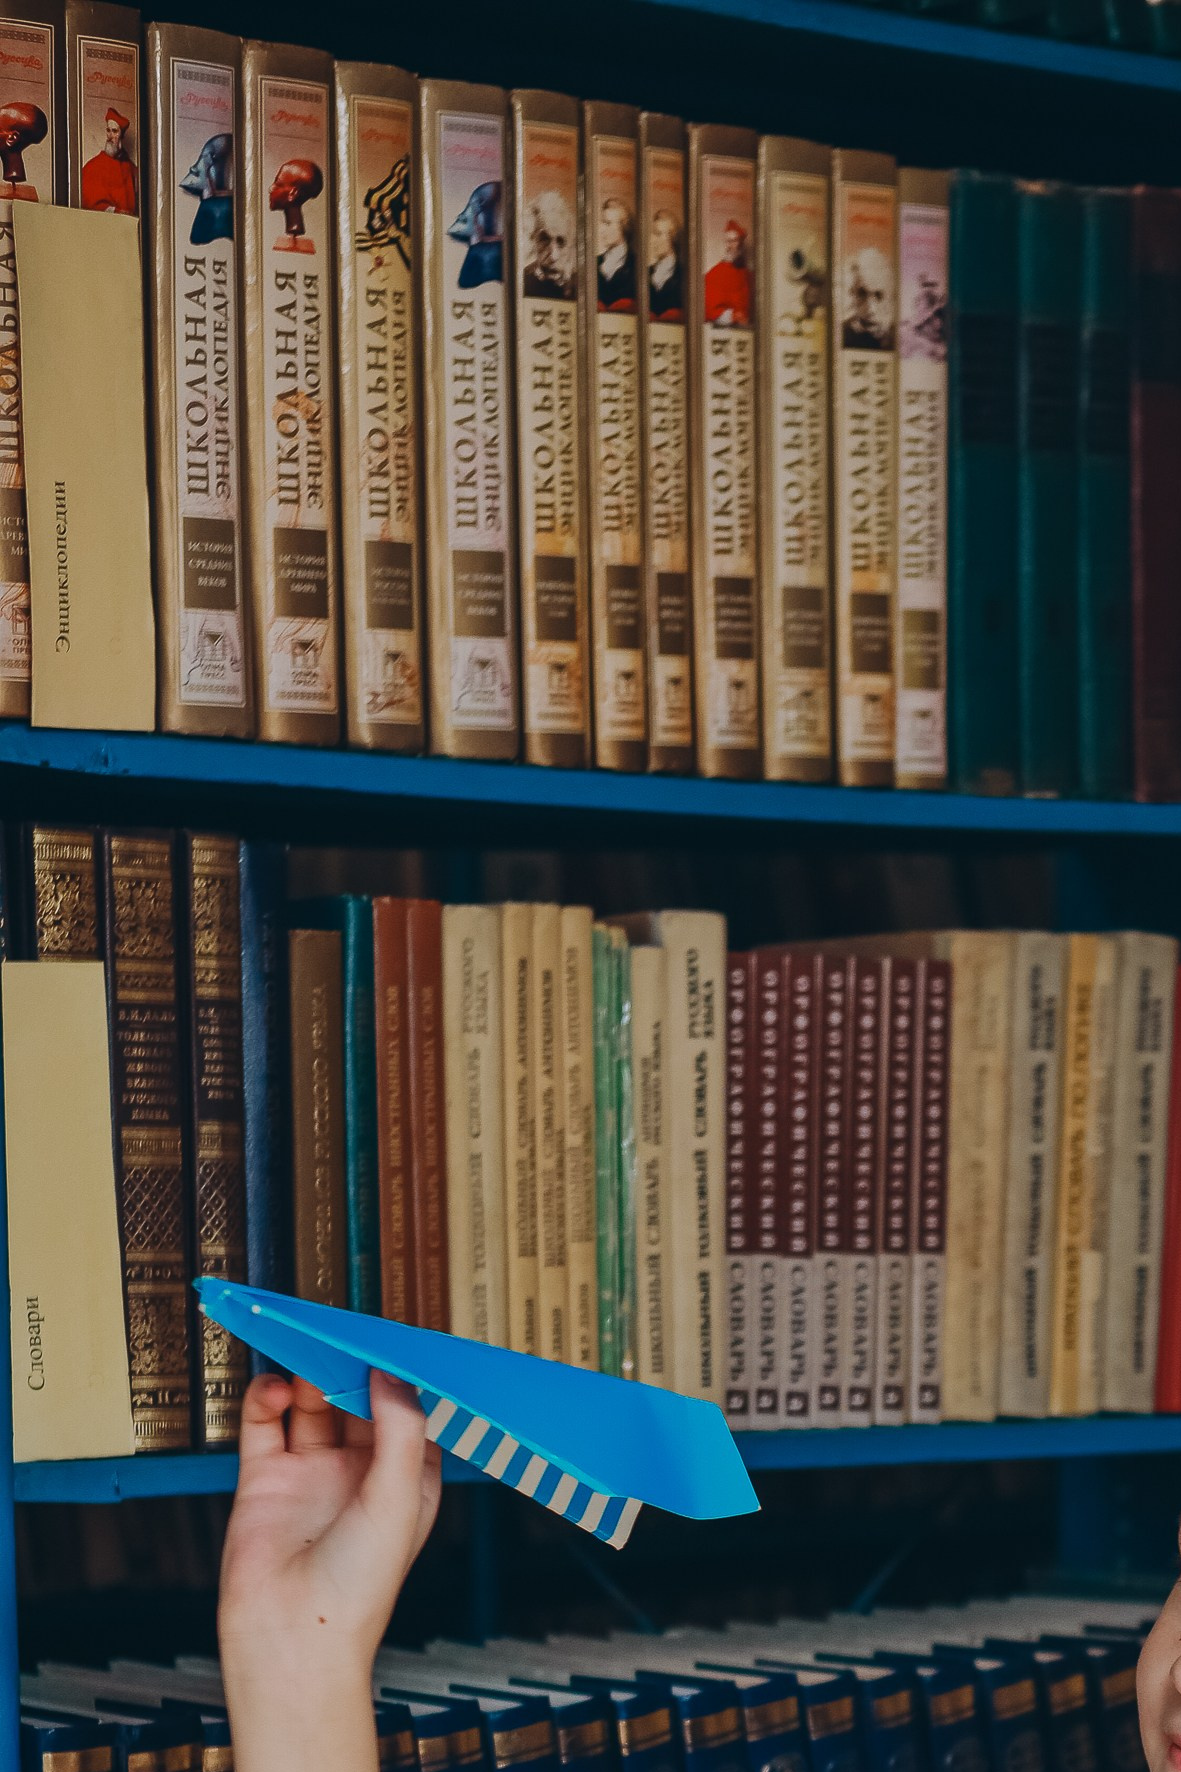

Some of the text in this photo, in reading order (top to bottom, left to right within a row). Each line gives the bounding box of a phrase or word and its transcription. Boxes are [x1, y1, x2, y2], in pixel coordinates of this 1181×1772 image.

[184, 255, 209, 497] ШКОЛЬНАЯ
[212, 259, 234, 501] ЭНЦИКЛОПЕДИЯ
[275, 269, 300, 507] ШКОЛЬНАЯ
[303, 273, 324, 510] ЭНЦИКЛОПЕДИЯ
[366, 288, 390, 519] ШКОЛЬНАЯ
[452, 300, 478, 529] ШКОЛЬНАЯ
[532, 309, 556, 535] ШКОЛЬНАЯ
[711, 338, 734, 556] ШКОЛЬНАЯ
[55, 480, 71, 654] Энциклопедии
[692, 1051, 709, 1138] СЛОВАРЬ
[645, 1158, 664, 1376] ШКОЛЬНЫЙ СЛОВАРЬ
[693, 1149, 711, 1260] ТОЛКОВЫЙ
[26, 1295, 45, 1392] Словари
[730, 1261, 745, 1383] СЛОВАРЬ
[759, 1260, 776, 1381] СЛОВАРЬ
[790, 1264, 808, 1384] СЛОВАРЬ
[822, 1259, 840, 1378] СЛОВАРЬ
[852, 1261, 870, 1379] СЛОВАРЬ
[886, 1260, 904, 1378] СЛОВАРЬ
[921, 1259, 940, 1378] СЛОВАРЬ
